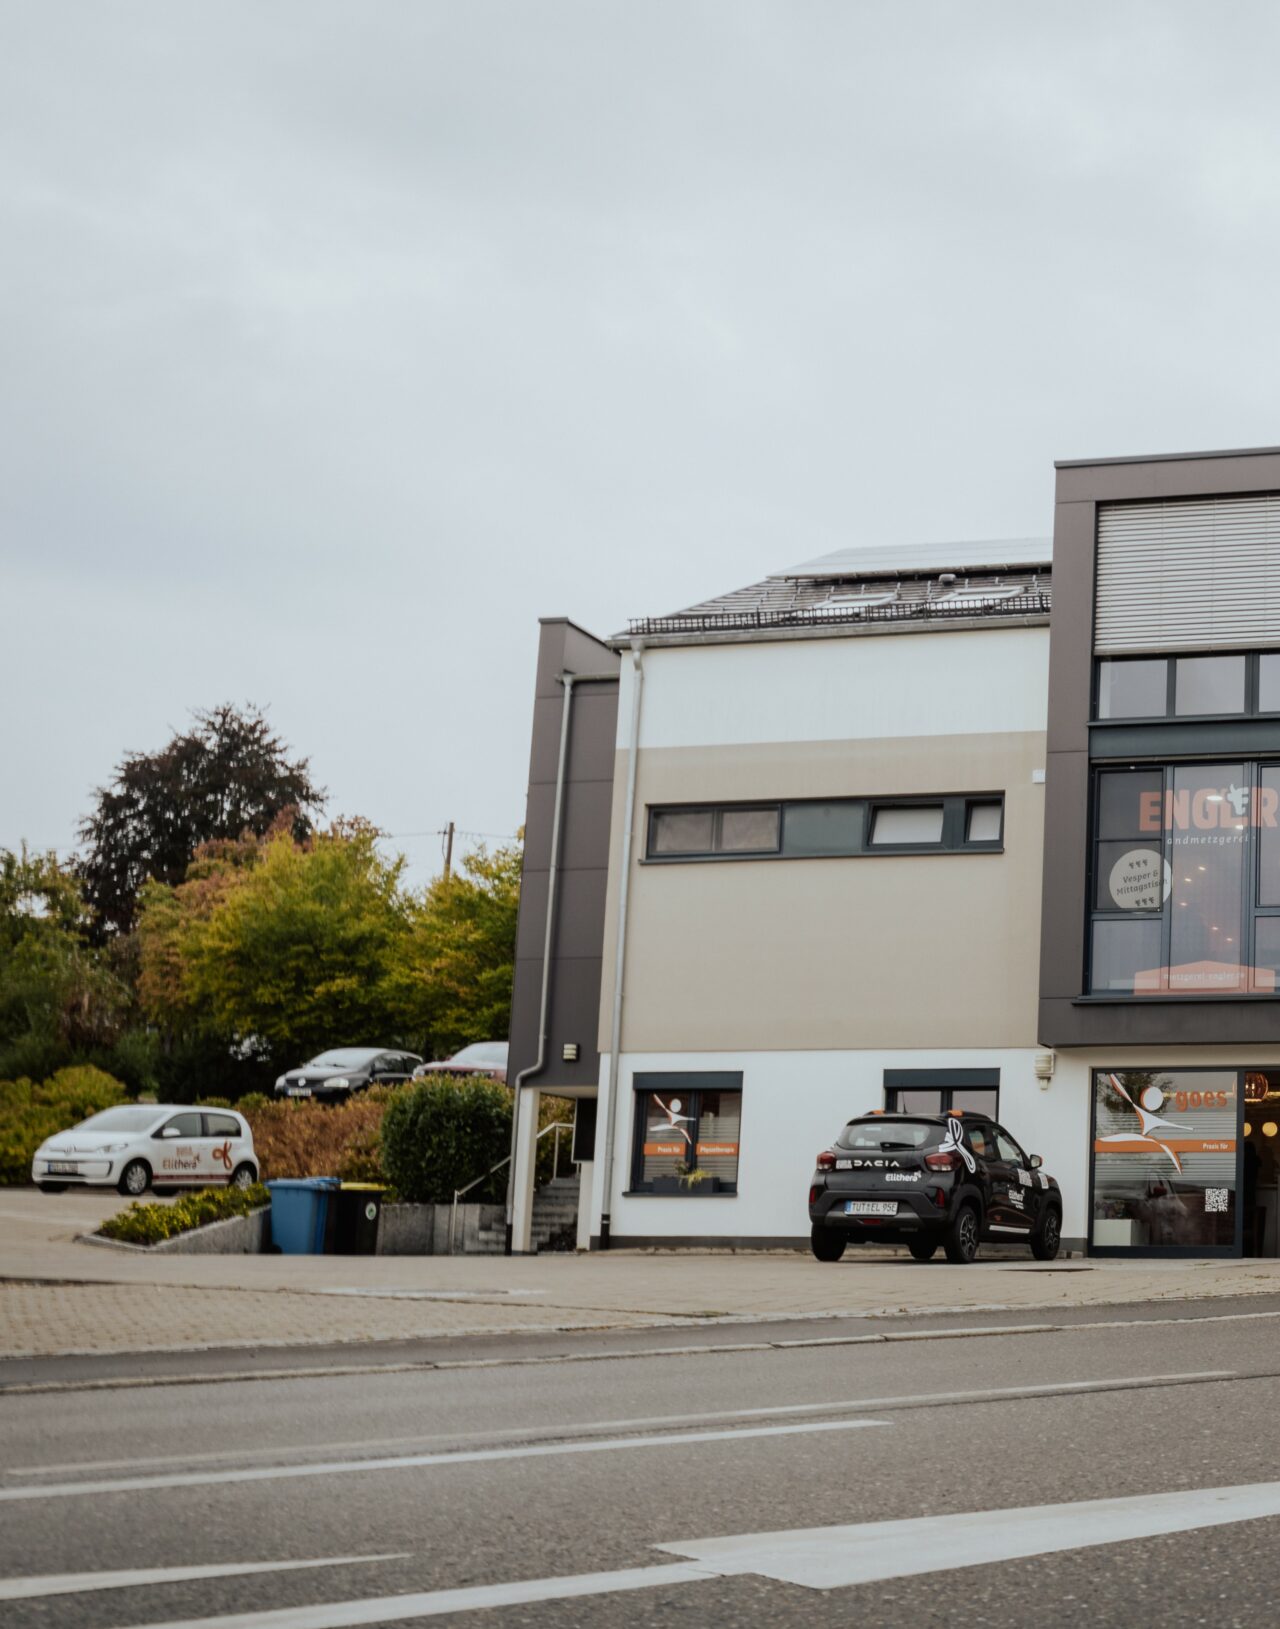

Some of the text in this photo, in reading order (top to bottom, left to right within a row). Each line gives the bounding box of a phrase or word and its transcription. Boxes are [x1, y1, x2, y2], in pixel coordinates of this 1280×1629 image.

[1139, 786, 1279, 831] ENGLER
[1167, 833, 1249, 846] andmetzgerei
[1122, 872, 1151, 885] Vesper
[1175, 1090, 1228, 1112] goes
[885, 1173, 918, 1182] Elithera
